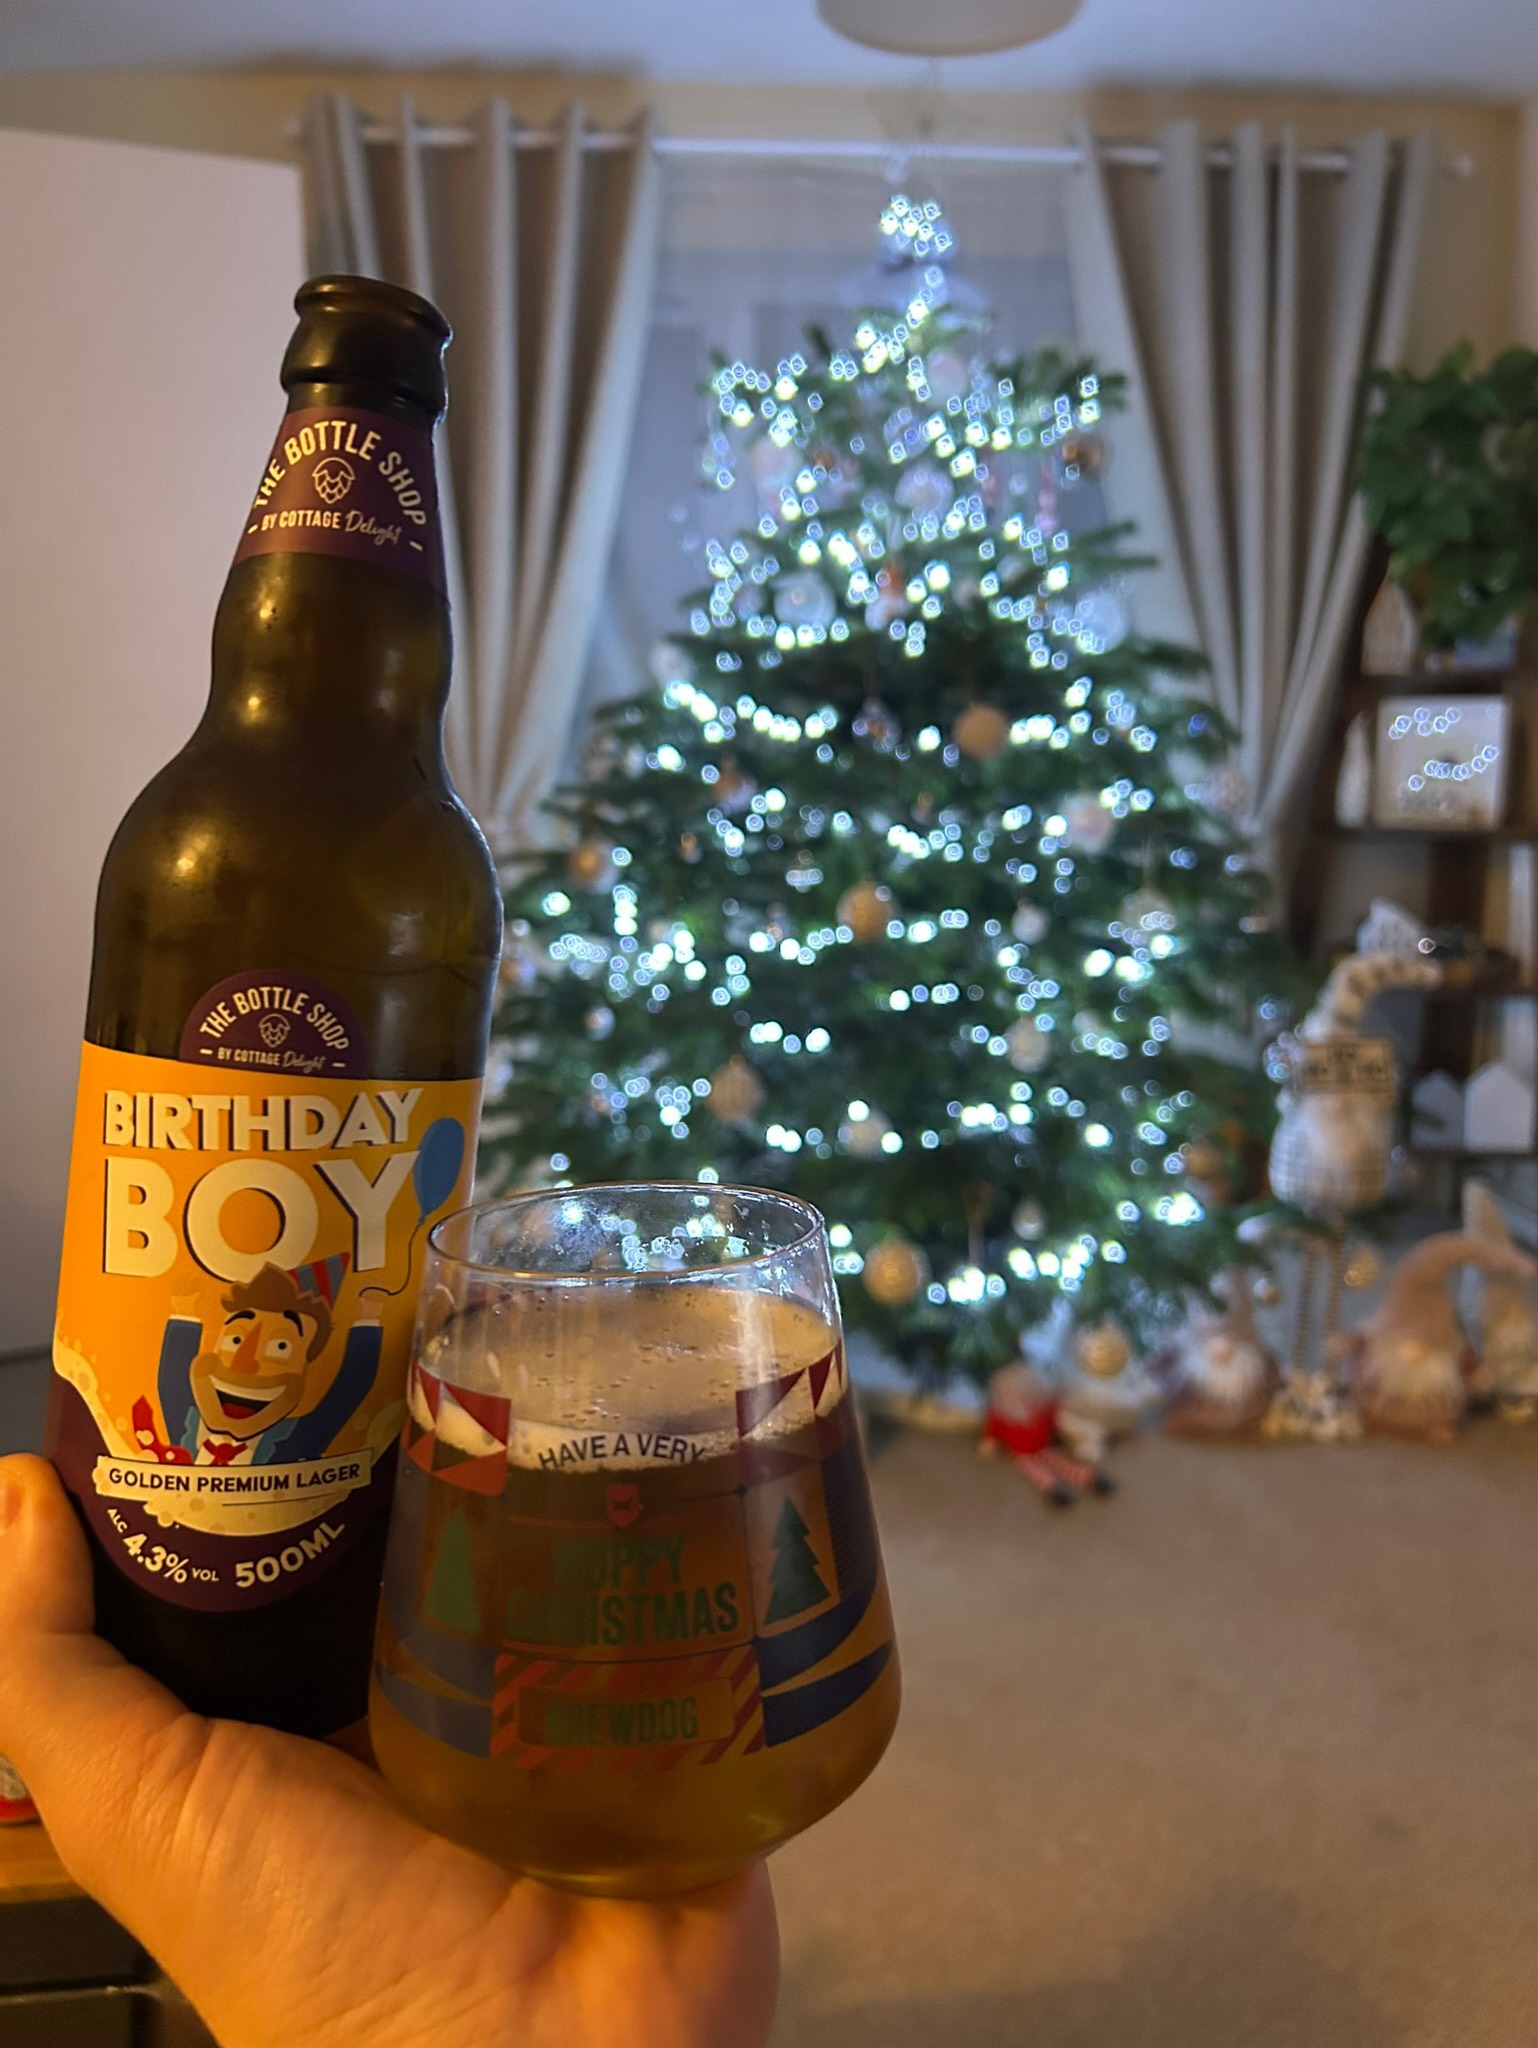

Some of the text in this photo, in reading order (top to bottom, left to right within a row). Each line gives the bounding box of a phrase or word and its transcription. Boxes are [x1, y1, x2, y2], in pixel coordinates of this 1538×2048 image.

[253, 420, 427, 526] THE BOTTLE SHOP
[261, 509, 403, 546] BY COTTAGE Delight
[200, 986, 349, 1050] THE BOTTLE SHOP
[217, 1047, 327, 1074] BY COTTAGE Delight
[103, 1087, 423, 1151] BIRTHDAY
[102, 1150, 421, 1284] BOY
[109, 1463, 361, 1493] GOLDEN PREMIUM LAGER
[538, 1433, 706, 1471] HAVE A VERY
[107, 1508, 346, 1588] ALC 4.3% VOL 500ML
[555, 1532, 686, 1589] HOPPY
